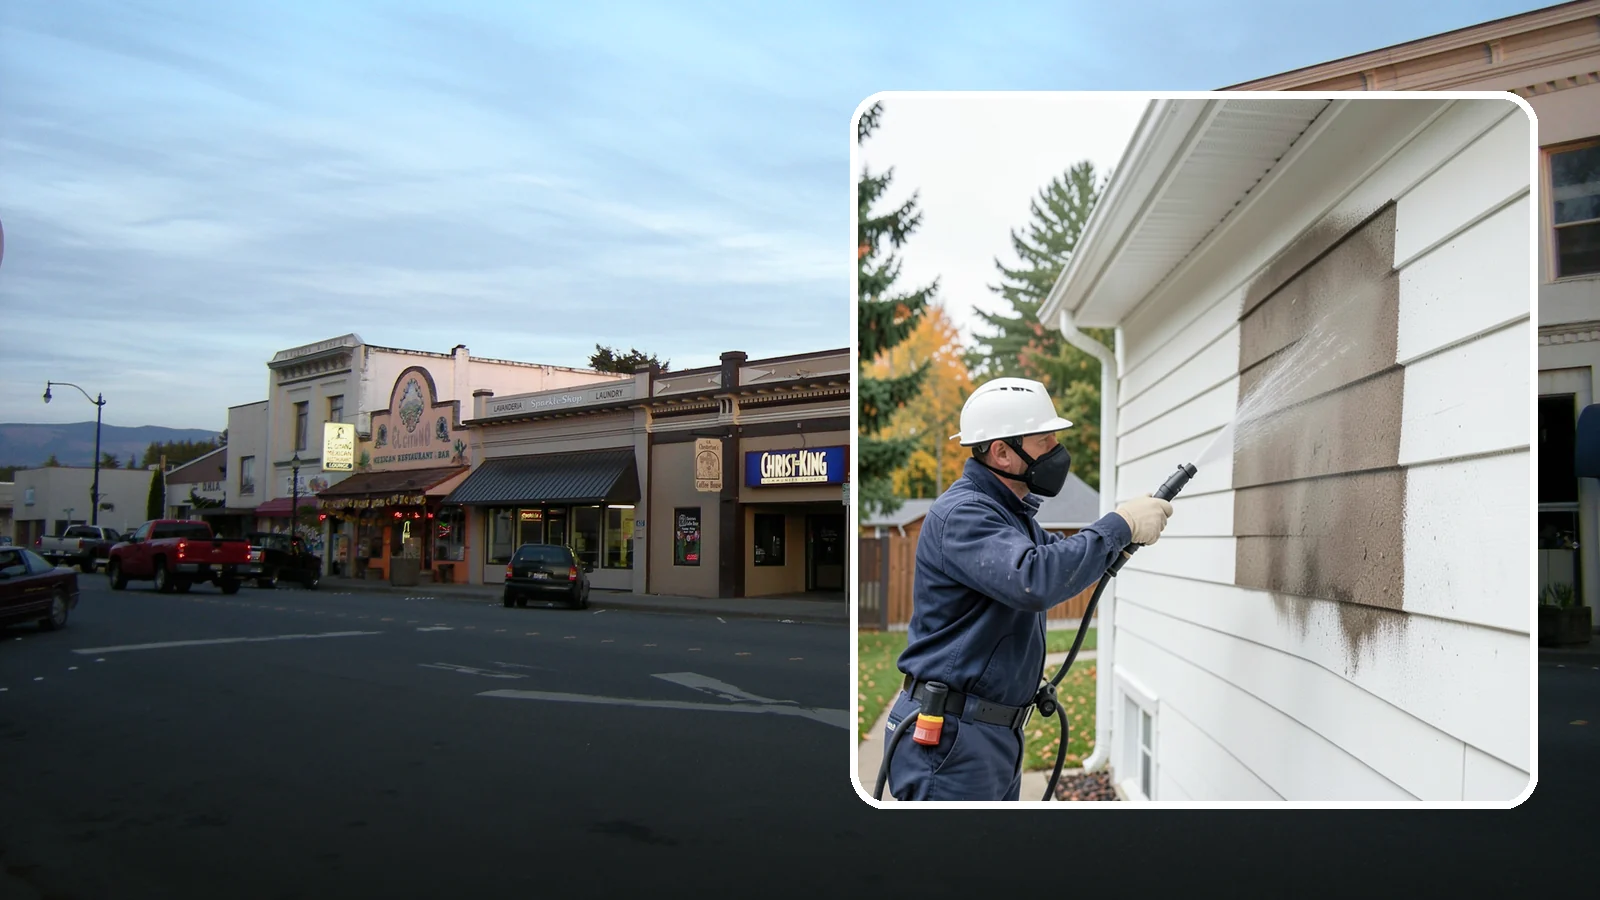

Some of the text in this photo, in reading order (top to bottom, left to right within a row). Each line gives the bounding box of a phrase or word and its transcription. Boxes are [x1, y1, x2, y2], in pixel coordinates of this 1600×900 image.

[595, 389, 624, 400] LAUNDRY
[493, 402, 523, 412] LAVANDERIA
[531, 395, 582, 409] Sparkle Shop
[374, 455, 395, 464] MEXICAN
[397, 451, 433, 462] RESTAURANT
[438, 450, 449, 459] BAR
[761, 450, 827, 478] CHRIST KING
